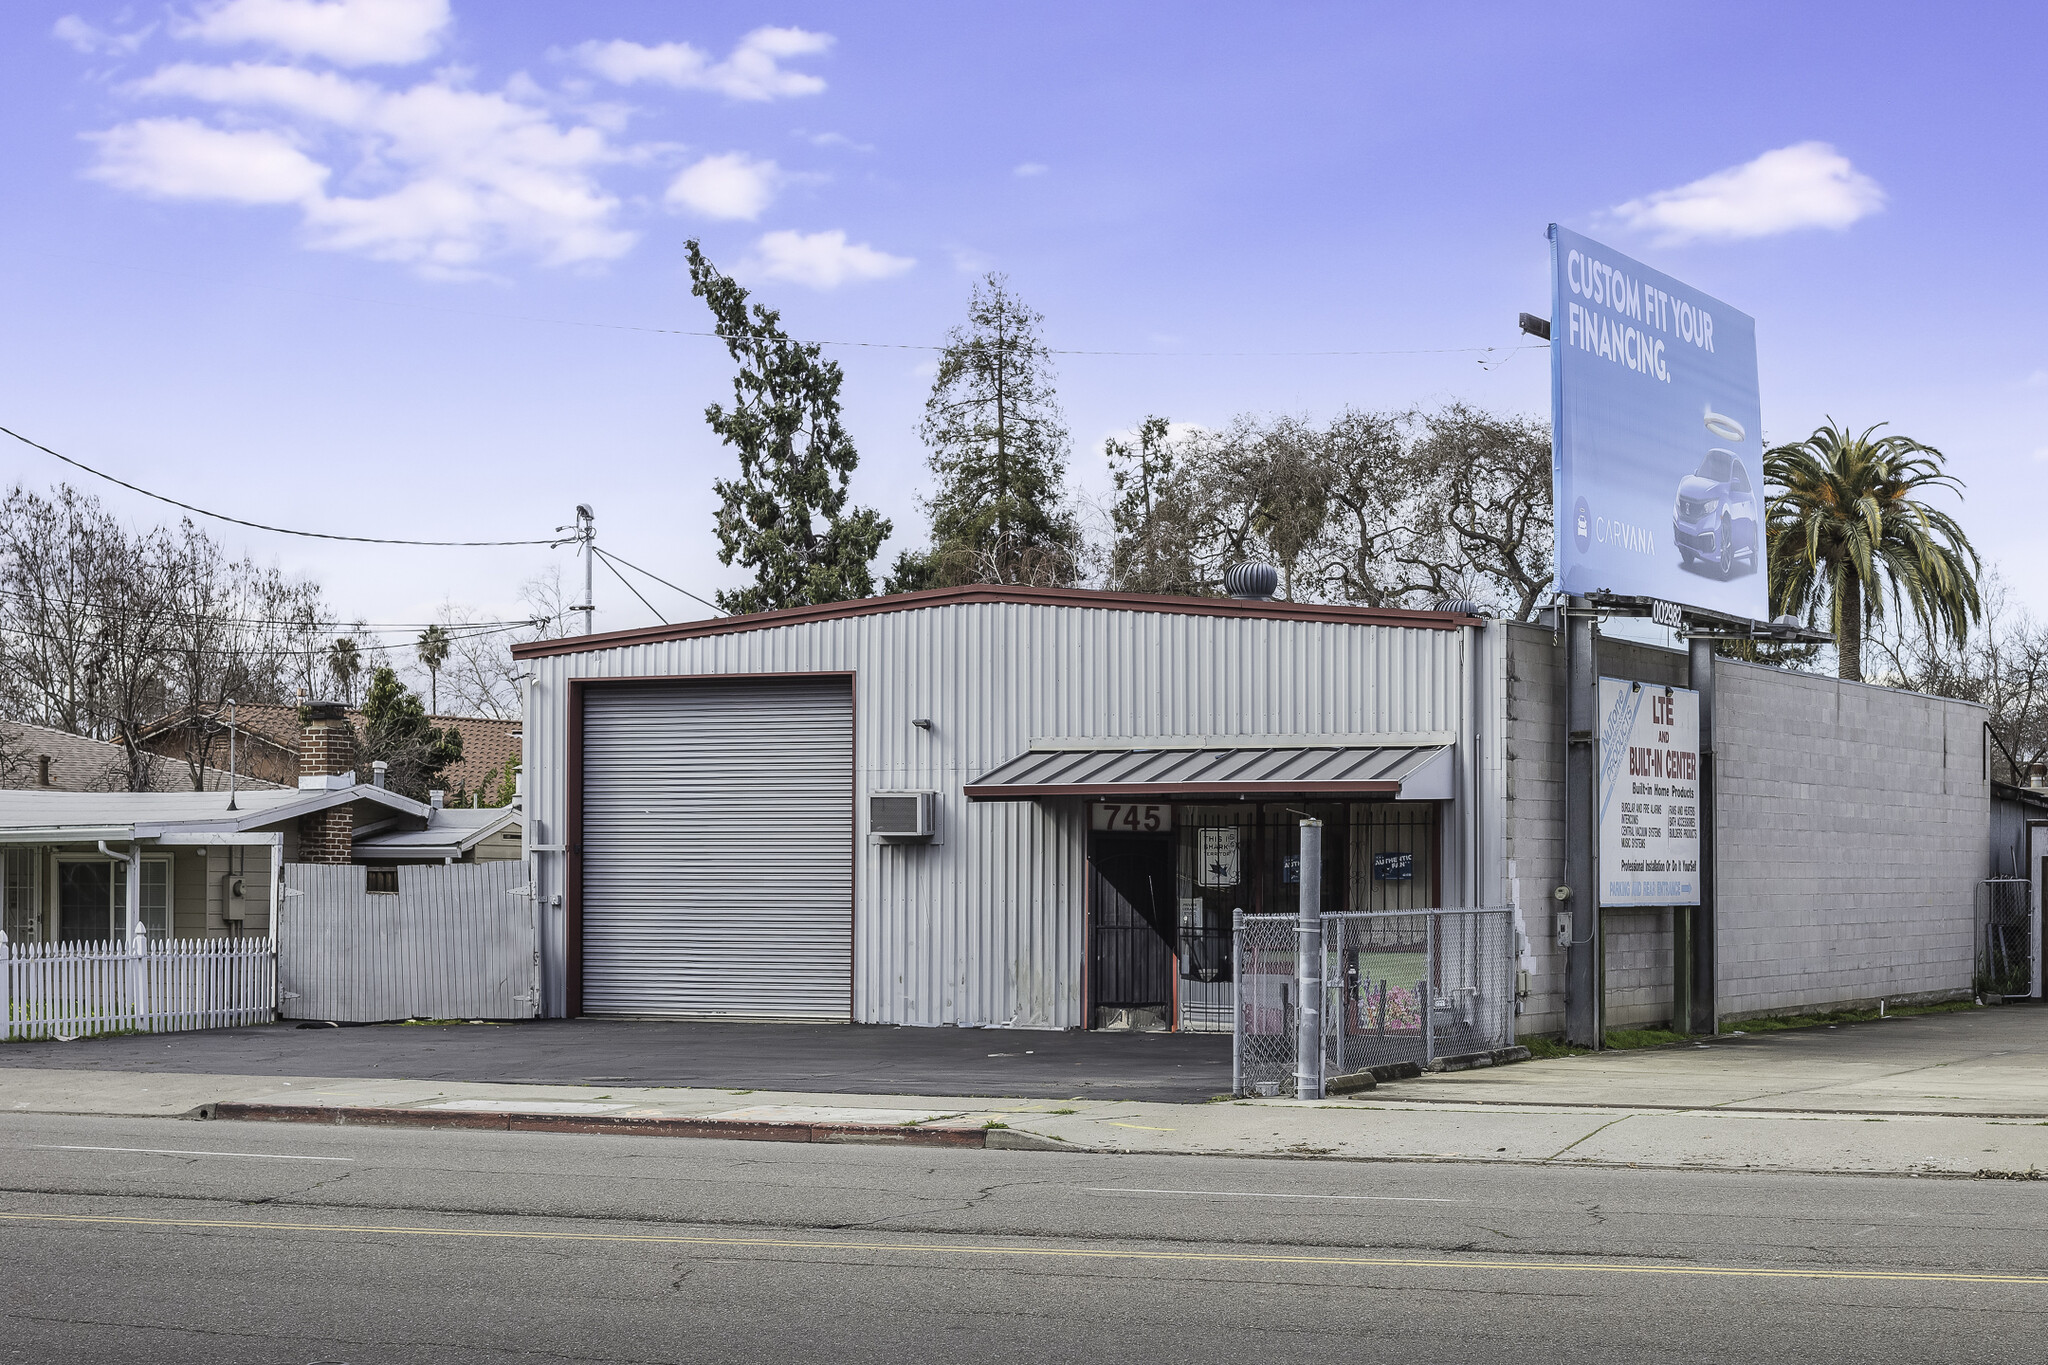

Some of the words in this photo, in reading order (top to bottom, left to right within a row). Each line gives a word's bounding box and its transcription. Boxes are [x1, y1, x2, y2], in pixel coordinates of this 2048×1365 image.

[1567, 249, 1642, 322] CUSTOM
[1644, 283, 1668, 333] FIT
[1670, 295, 1715, 354] YOUR
[1568, 301, 1671, 384] FINANCING.
[1595, 516, 1657, 556] CARVANA
[1653, 599, 1682, 628] 002982
[1652, 695, 1674, 726] LTE
[1606, 704, 1633, 784] PRODUCTS
[1658, 730, 1670, 744] AND
[1629, 746, 1663, 778] BUILT-IN
[1665, 749, 1697, 781] CENTER
[1632, 782, 1653, 796] Built-in
[1653, 785, 1670, 797] Home
[1671, 785, 1695, 799] Products
[1103, 804, 1161, 832] 745
[1621, 859, 1645, 872] Professional
[1645, 860, 1665, 872] Installation
[1672, 860, 1678, 872] Do
[1609, 881, 1631, 897] PARKING
[1631, 881, 1642, 897] AND
[1643, 881, 1655, 897] REAR
[1656, 881, 1681, 897] ENTRANCE
